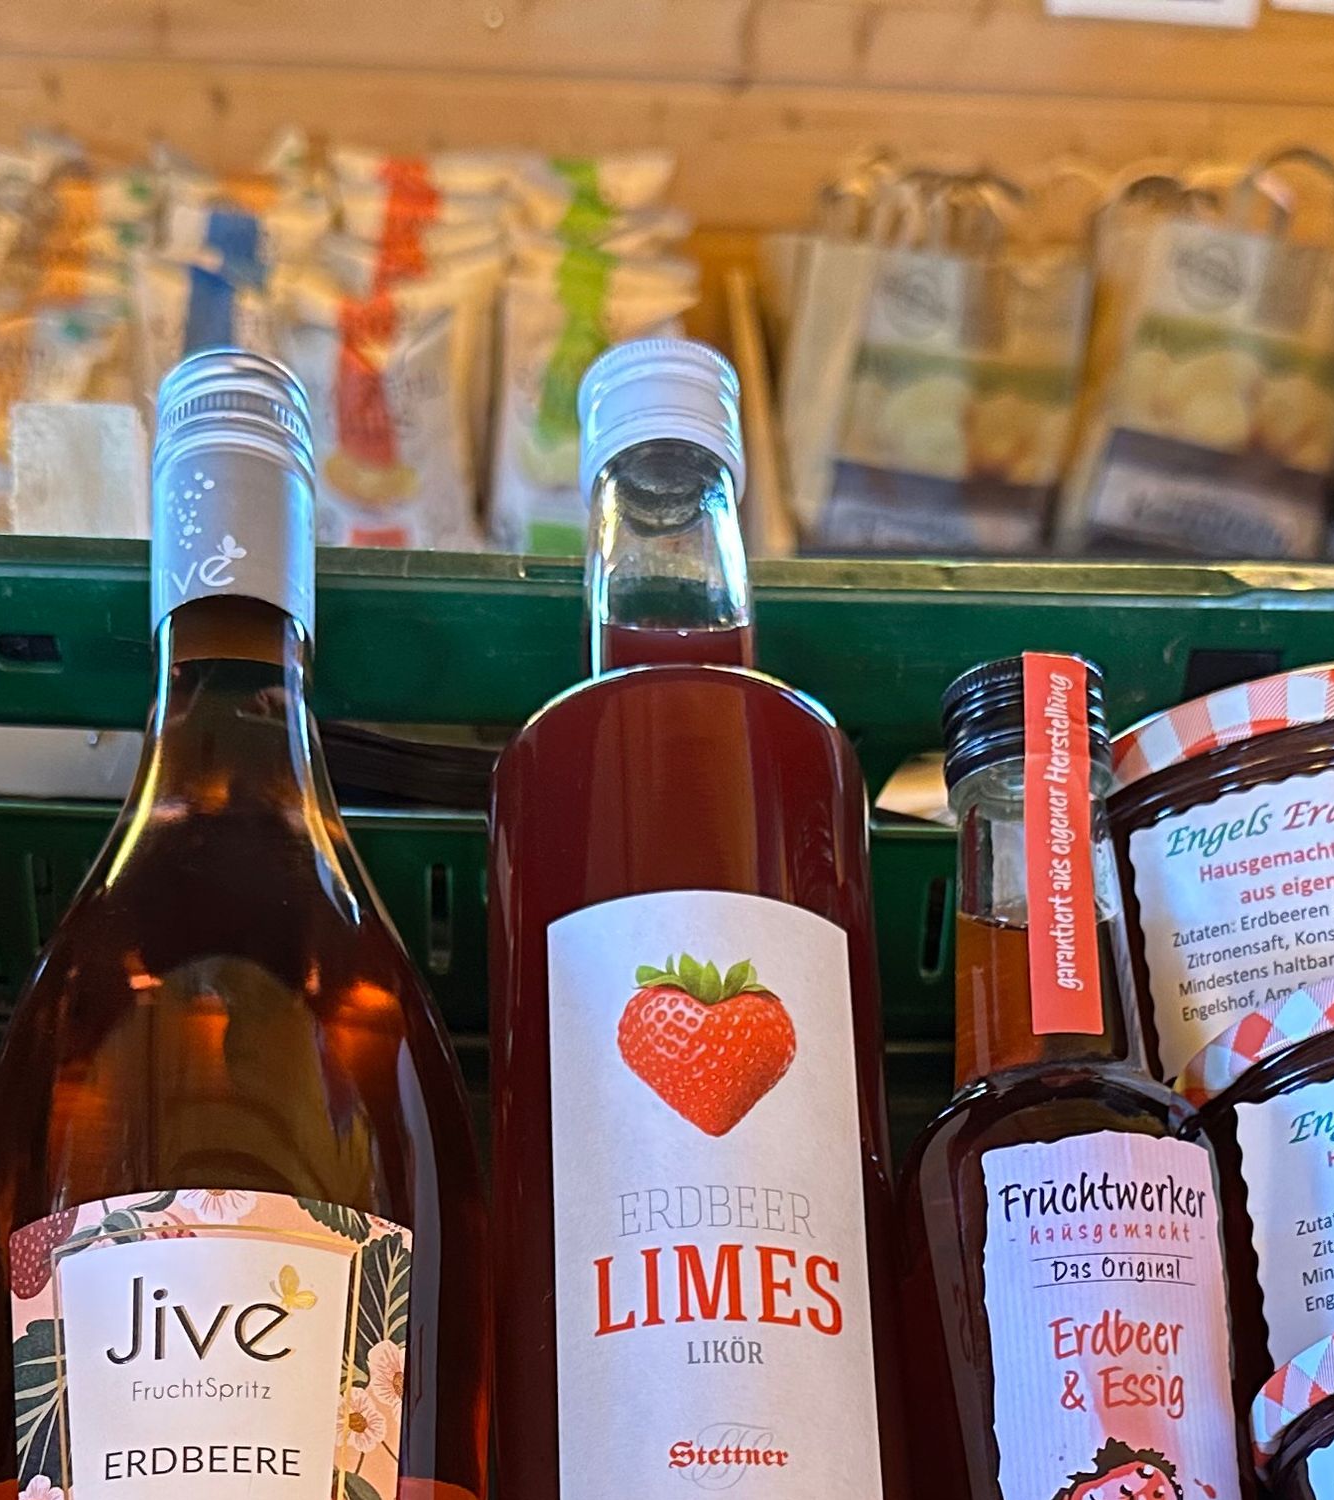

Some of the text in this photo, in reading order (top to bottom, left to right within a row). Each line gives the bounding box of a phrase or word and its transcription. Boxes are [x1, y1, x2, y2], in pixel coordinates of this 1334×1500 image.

[1045, 786, 1076, 855] eigener
[1166, 803, 1273, 858] Engels
[1240, 885, 1276, 904] aus
[1048, 894, 1084, 991] garantiert
[1172, 922, 1235, 948] Zutaten:
[1240, 904, 1329, 931] Erdbeeren
[1187, 935, 1290, 970] Zitronensaft,
[1179, 965, 1269, 997] Mindestens
[1273, 953, 1334, 976] haltbar
[1182, 988, 1292, 1022] Engelshof, Am
[618, 1184, 816, 1239] ERDBEER
[593, 1243, 843, 1337] LIMES
[1051, 1256, 1181, 1282] Das Original
[106, 1276, 293, 1366] Jive
[1048, 1309, 1184, 1360] Erdbeer
[687, 1336, 764, 1365] LIKÖR
[132, 1377, 272, 1402] FruchtSpritz
[1060, 1366, 1185, 1419] & Essig
[105, 1445, 301, 1481] ERDBEERE
[668, 1440, 789, 1469] Stettner
